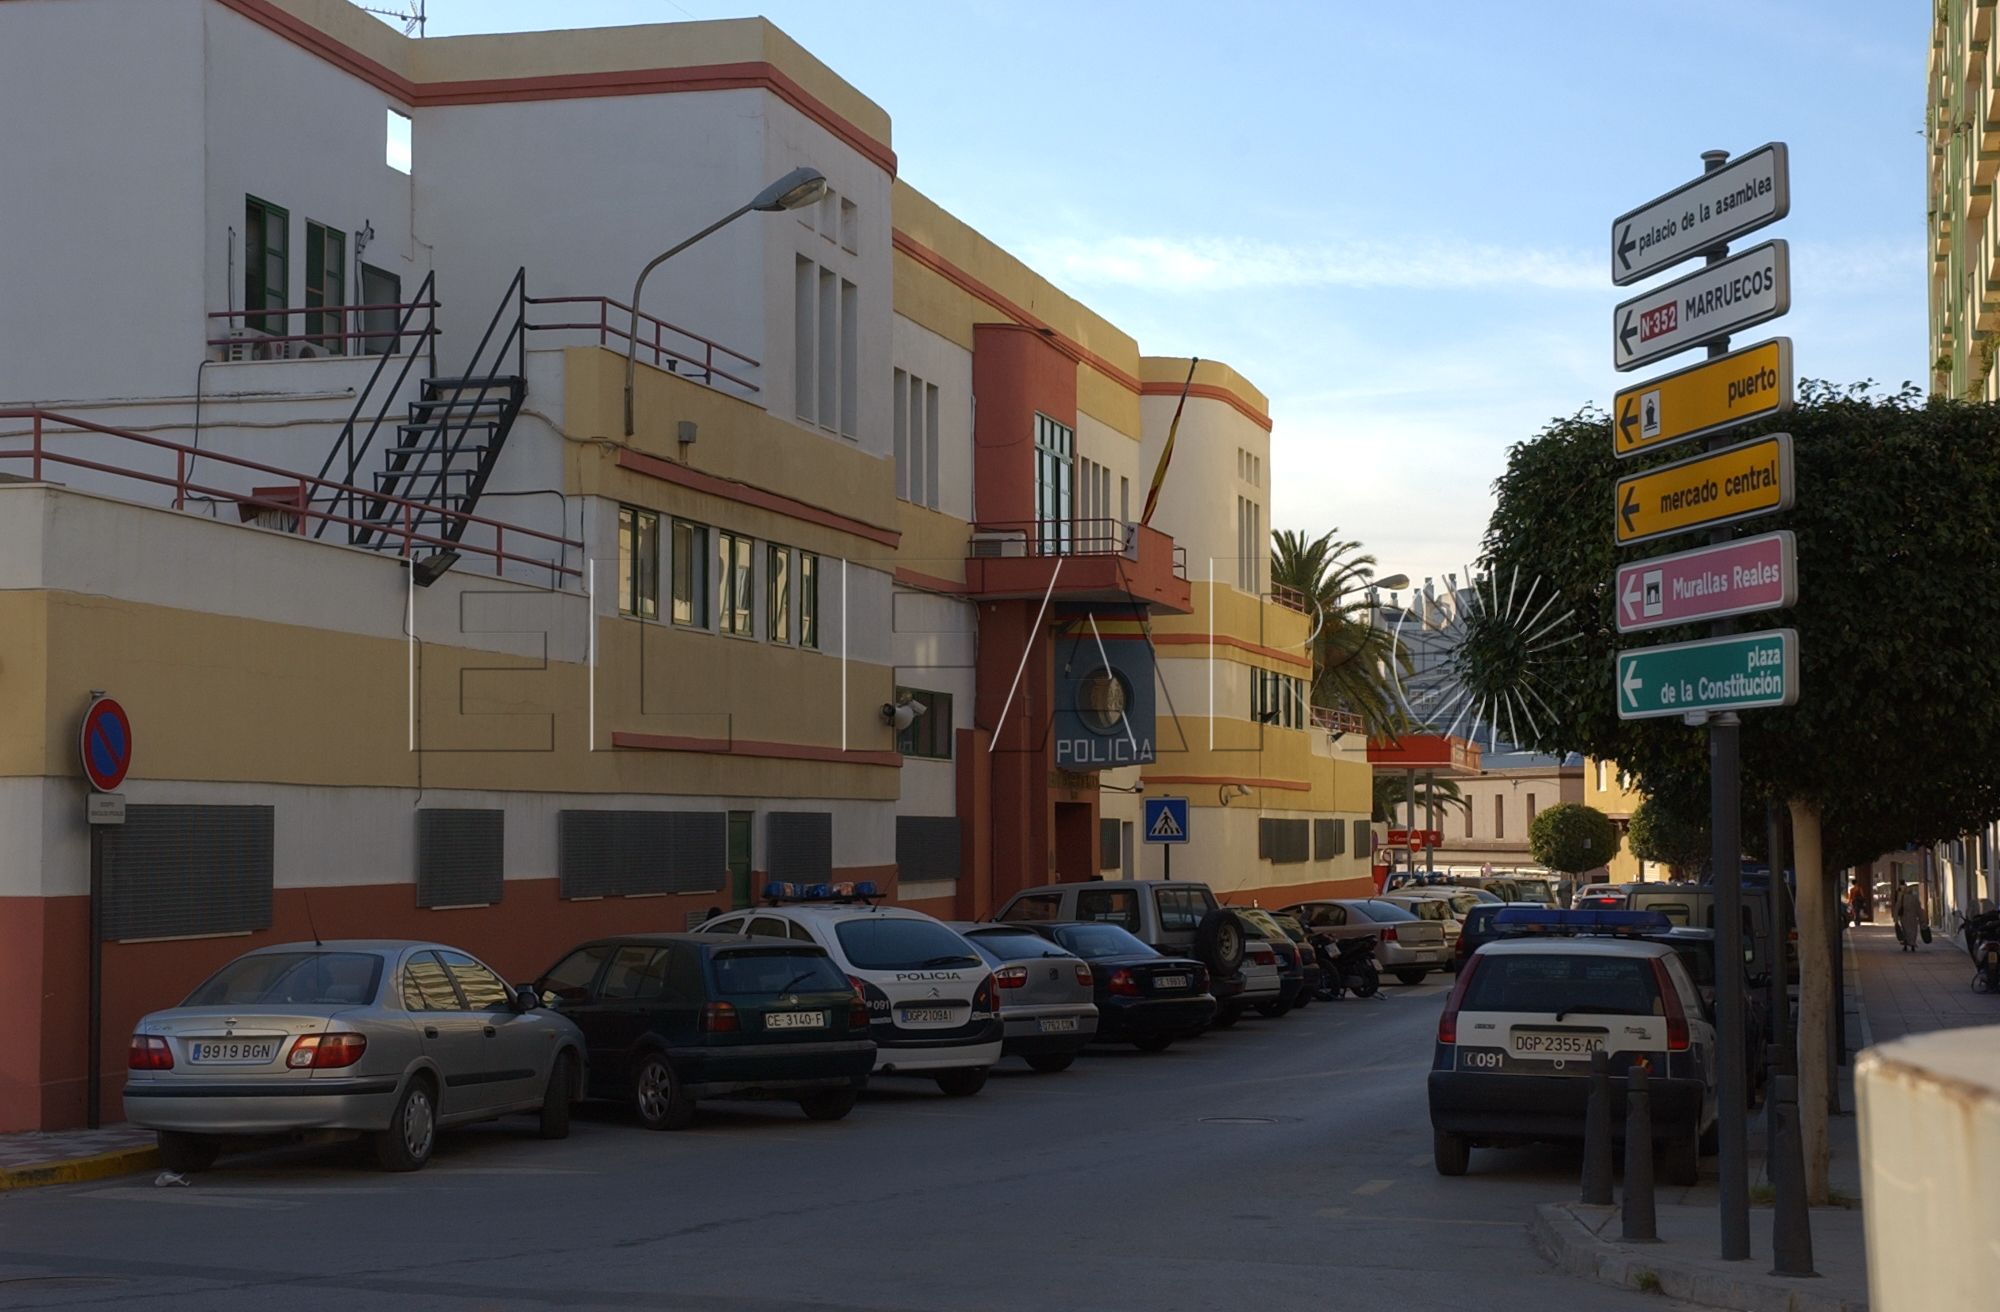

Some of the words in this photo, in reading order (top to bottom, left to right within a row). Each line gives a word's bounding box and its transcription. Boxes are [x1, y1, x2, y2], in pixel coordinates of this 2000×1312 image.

[1638, 219, 1677, 256] palacio
[1681, 211, 1695, 232] de
[1699, 203, 1711, 223] la
[1715, 176, 1773, 216] asamblea
[1641, 306, 1677, 338] N-352
[1685, 266, 1774, 322] MARRUECOS
[1728, 366, 1777, 408] puerto
[1660, 479, 1718, 514] mercado
[1724, 459, 1777, 497] central
[1672, 571, 1728, 601] Murallas
[1733, 561, 1780, 589] Reales
[1747, 645, 1781, 673] plaza
[1660, 682, 1676, 704] de
[1680, 679, 1694, 702] la
[1698, 670, 1782, 700] Constitución
[1056, 738, 1153, 763] POLICIA
[895, 971, 962, 982] POLICIA
[873, 1000, 890, 1010] 091
[202, 1044, 239, 1060] 9919
[242, 1043, 271, 1058] BGN
[1476, 1052, 1504, 1068] 091
